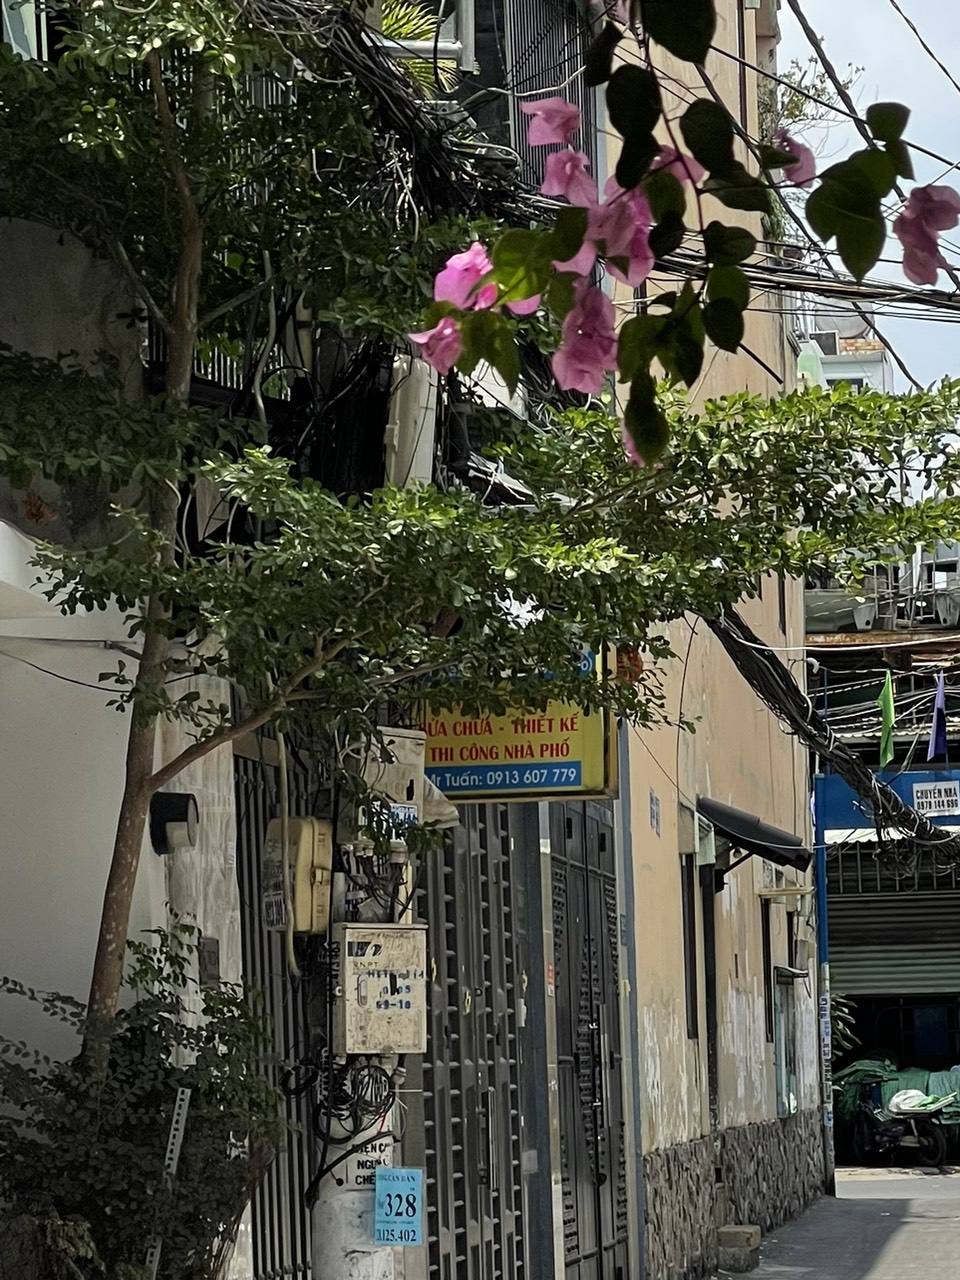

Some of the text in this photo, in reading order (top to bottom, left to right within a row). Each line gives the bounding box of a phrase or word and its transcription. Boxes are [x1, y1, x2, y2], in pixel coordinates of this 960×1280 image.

[560, 711, 579, 732] KẾ
[429, 737, 570, 762] THI CÔNG NHÀ PHỐ
[444, 770, 483, 787] Tuấn:
[486, 770, 519, 785] 0913
[523, 768, 548, 783] 607
[552, 767, 577, 782] 779
[384, 1192, 417, 1217] 328
